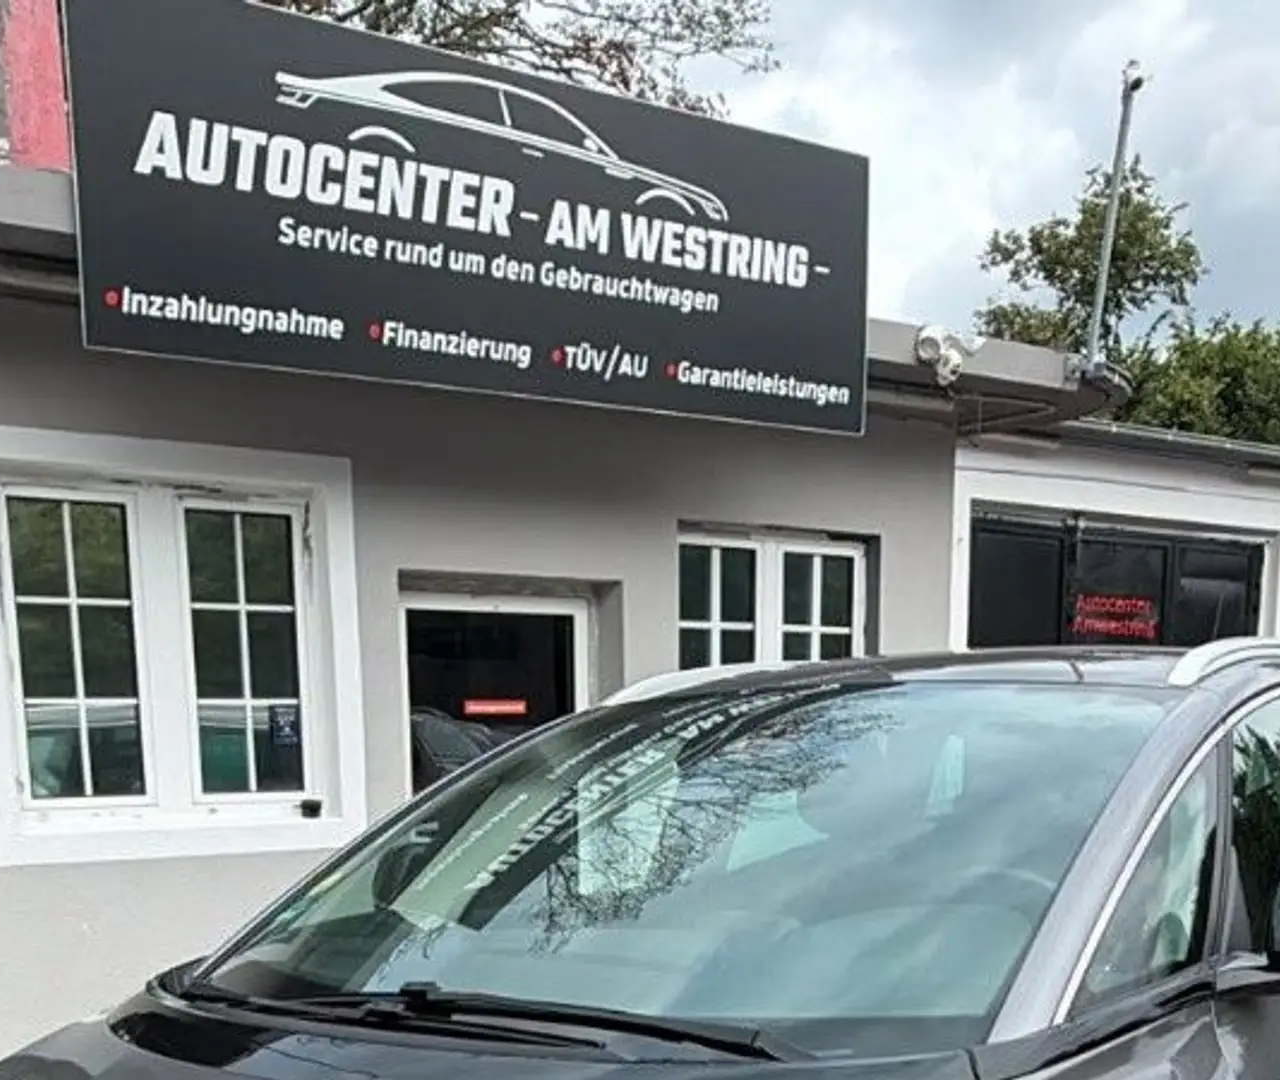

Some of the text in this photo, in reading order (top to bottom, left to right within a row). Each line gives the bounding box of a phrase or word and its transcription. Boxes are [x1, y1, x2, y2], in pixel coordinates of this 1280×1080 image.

[133, 111, 514, 237] AUTOCENTER
[544, 200, 610, 255] AM
[620, 212, 809, 289] WESTRING
[277, 217, 719, 314] Service rund um den Gebrauchtwagen
[121, 286, 850, 405] Inzahlungnahme Finanzierung TÜV/AU Garantieleistungen
